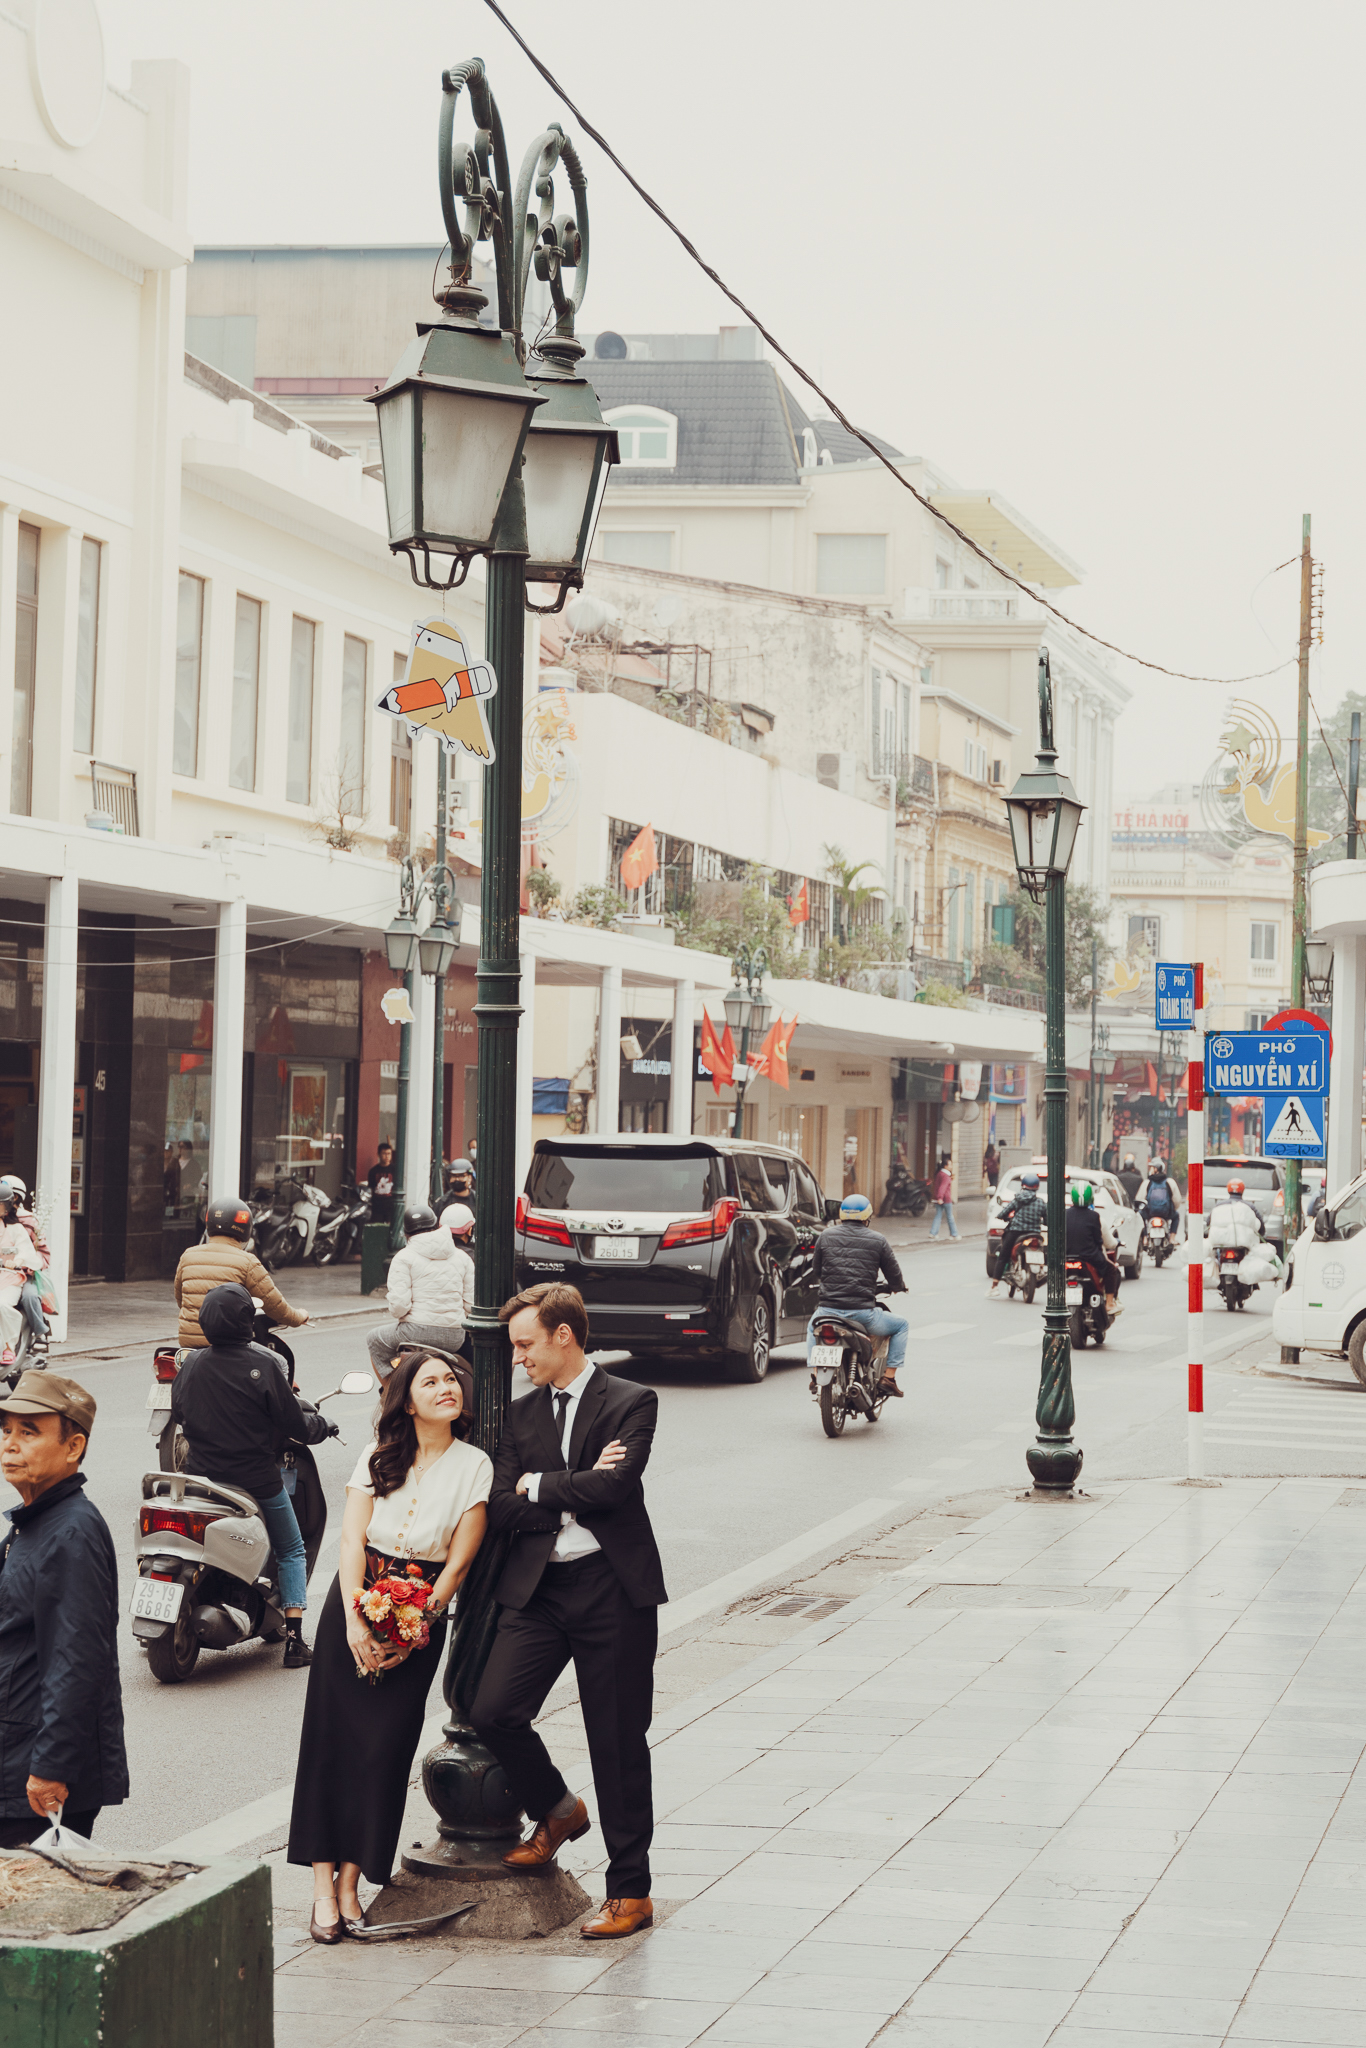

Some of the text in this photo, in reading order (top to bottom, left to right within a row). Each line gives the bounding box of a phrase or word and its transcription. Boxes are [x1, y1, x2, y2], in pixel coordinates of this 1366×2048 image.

[1115, 806, 1189, 832] TẾ HÀ NỘI
[1173, 970, 1186, 987] PHỐ
[1160, 991, 1180, 1020] TRÀNG
[1259, 1038, 1297, 1053] PHỐ
[95, 1070, 106, 1091] 45
[1215, 1056, 1318, 1087] NGUYỄN XÍ
[608, 1237, 627, 1247] 30H
[600, 1248, 633, 1259] 260.15
[139, 1581, 176, 1602] 29-Y9
[136, 1599, 172, 1619] 8686
